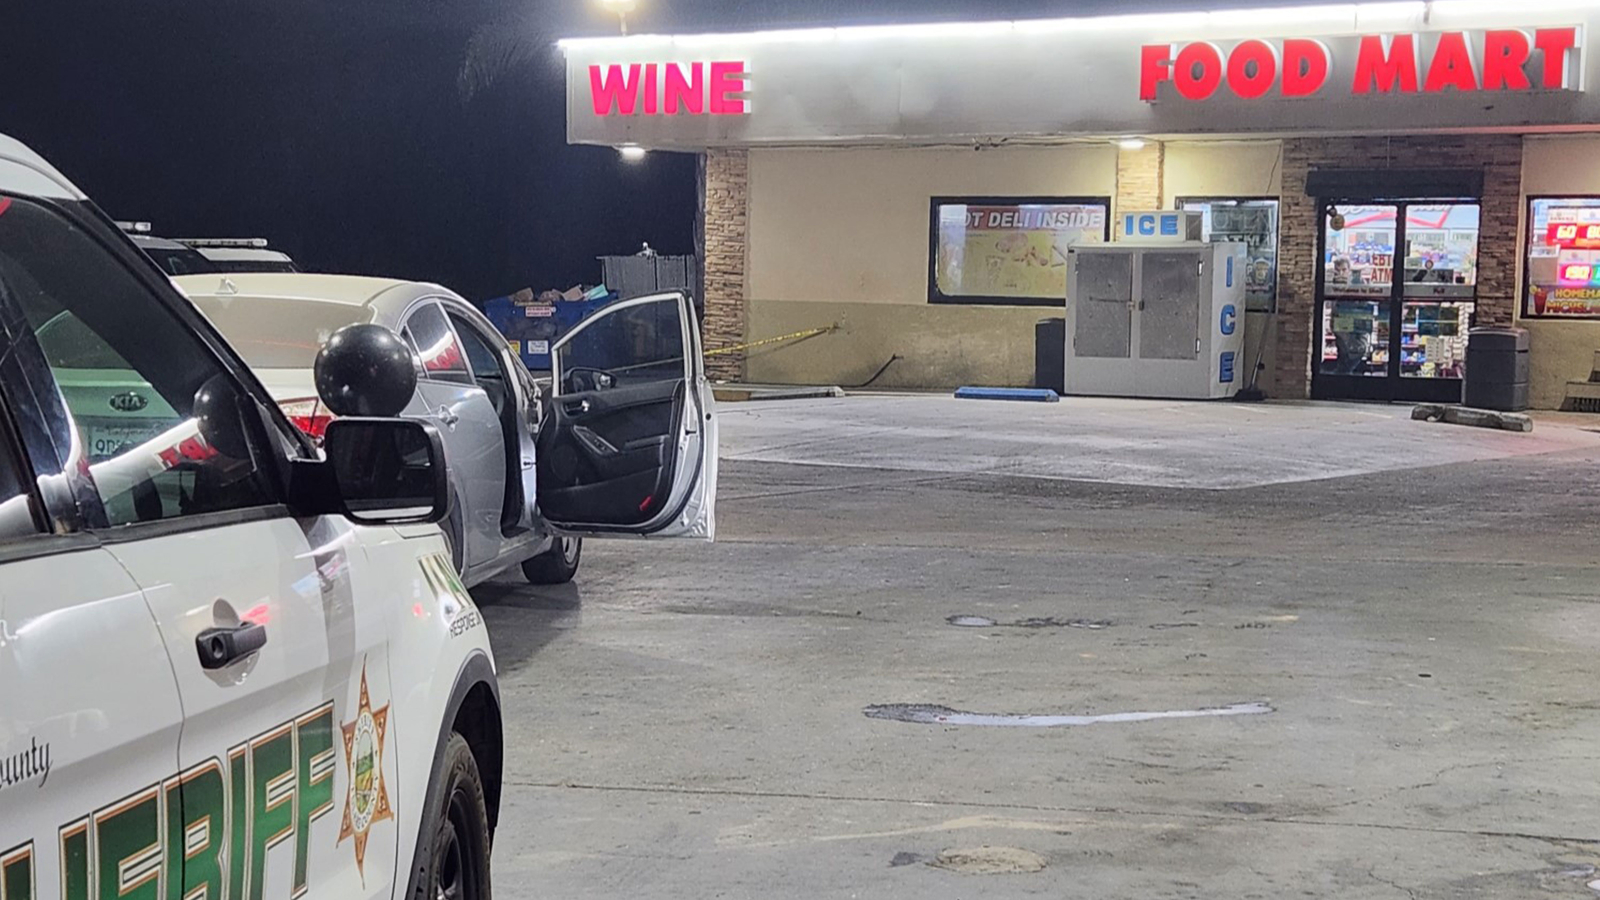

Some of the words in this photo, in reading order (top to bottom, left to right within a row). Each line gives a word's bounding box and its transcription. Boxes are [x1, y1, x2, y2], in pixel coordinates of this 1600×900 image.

[1140, 39, 1328, 101] FOOD
[1352, 27, 1576, 95] MART
[588, 60, 744, 115] WINE
[988, 211, 1029, 228] DELI
[1036, 212, 1101, 229] INSIDE
[1125, 214, 1179, 236] ICE
[1219, 256, 1236, 383] ICE
[114, 396, 141, 407] KIA
